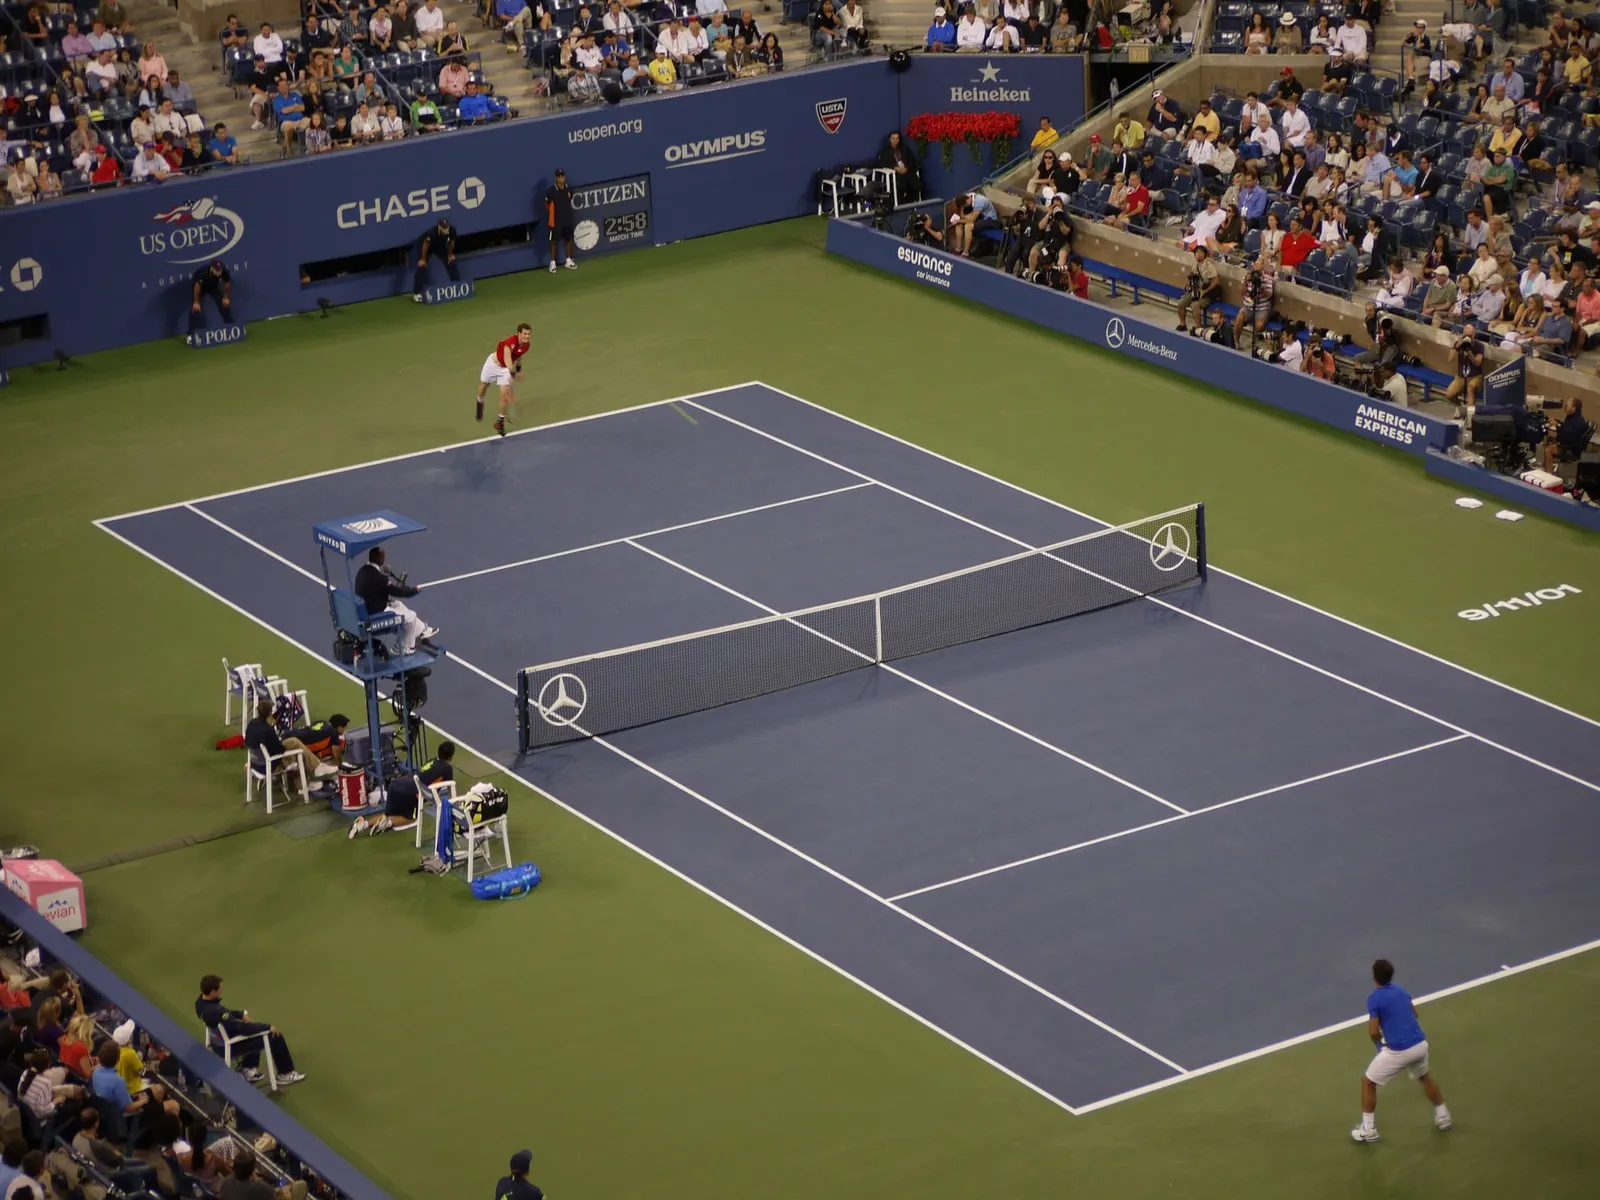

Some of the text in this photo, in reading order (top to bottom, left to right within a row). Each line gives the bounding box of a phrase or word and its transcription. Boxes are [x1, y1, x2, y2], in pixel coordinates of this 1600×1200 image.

[950, 87, 1031, 102] Heineken
[822, 103, 843, 113] USTA
[568, 119, 643, 143] usopen.org
[664, 130, 766, 162] OLYMPUS
[336, 185, 452, 229] CHASE
[570, 181, 646, 210] CITIZEN
[605, 212, 647, 236] 2:58
[631, 230, 644, 238] TIME
[139, 221, 229, 255] US OPEN
[897, 246, 952, 276] esurance
[916, 270, 951, 288] car insurance
[436, 282, 470, 301] POLO
[206, 325, 241, 345] POLO
[1127, 334, 1178, 360] Mercedes-Benz
[1488, 369, 1521, 382] OLYMPUS
[1355, 415, 1413, 444] EXPRESS
[1356, 404, 1427, 436] AMERICAN
[318, 533, 340, 549] UNITED
[1457, 583, 1582, 621] 9/11/01
[371, 619, 394, 630] NITED
